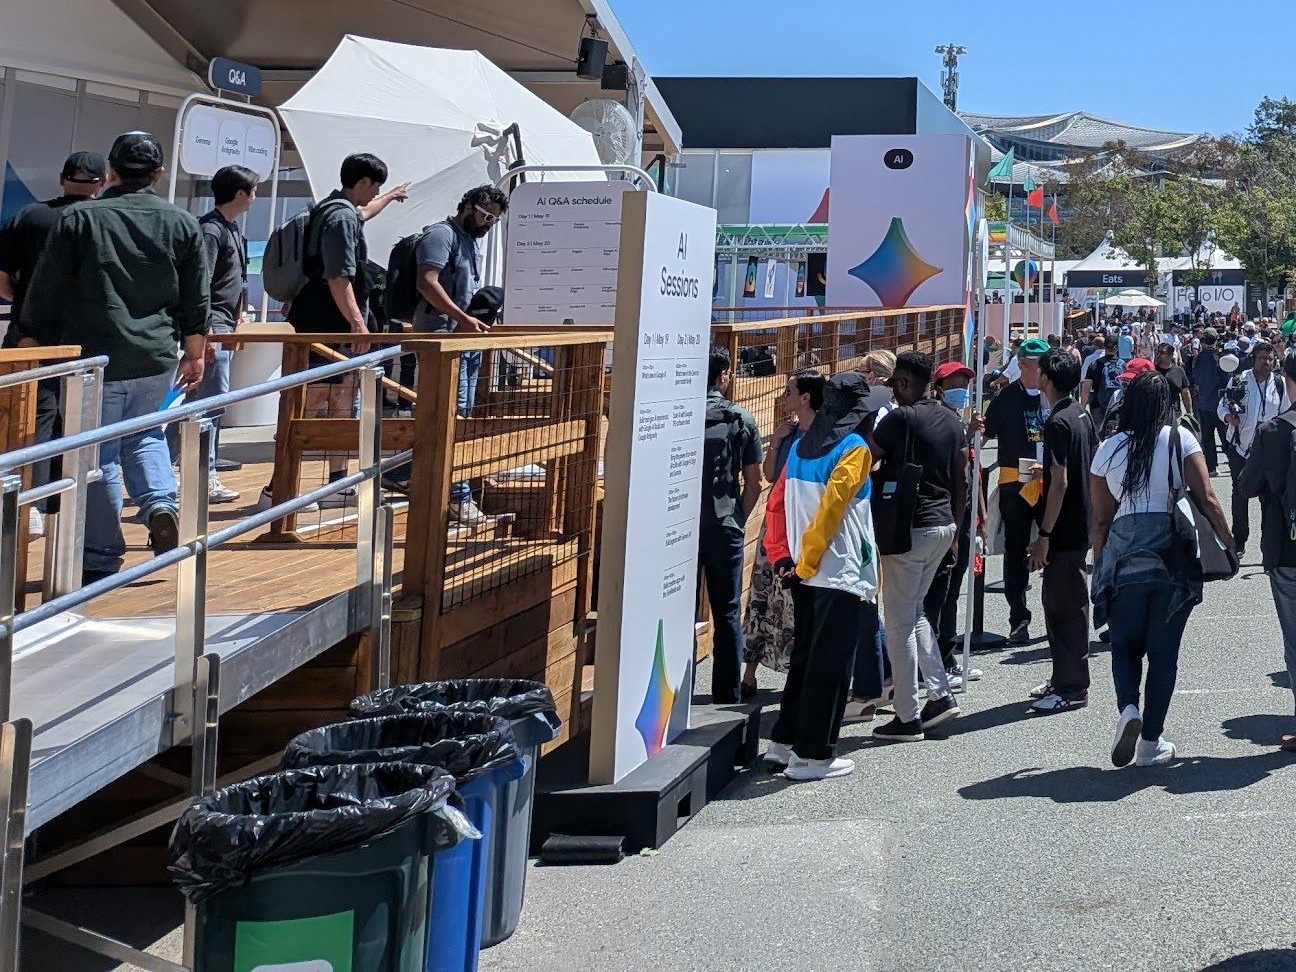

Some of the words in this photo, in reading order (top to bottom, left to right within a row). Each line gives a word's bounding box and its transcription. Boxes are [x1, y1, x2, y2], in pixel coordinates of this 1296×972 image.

[228, 69, 246, 86] Q&A
[225, 137, 238, 147] Google
[893, 154, 905, 164] AI
[537, 197, 546, 206] AI
[548, 197, 570, 206] Q&A
[571, 196, 612, 206] schedule
[677, 232, 688, 261] AI
[660, 266, 699, 299] Sessions
[1102, 274, 1123, 284] Eats
[1214, 288, 1235, 302] I/O
